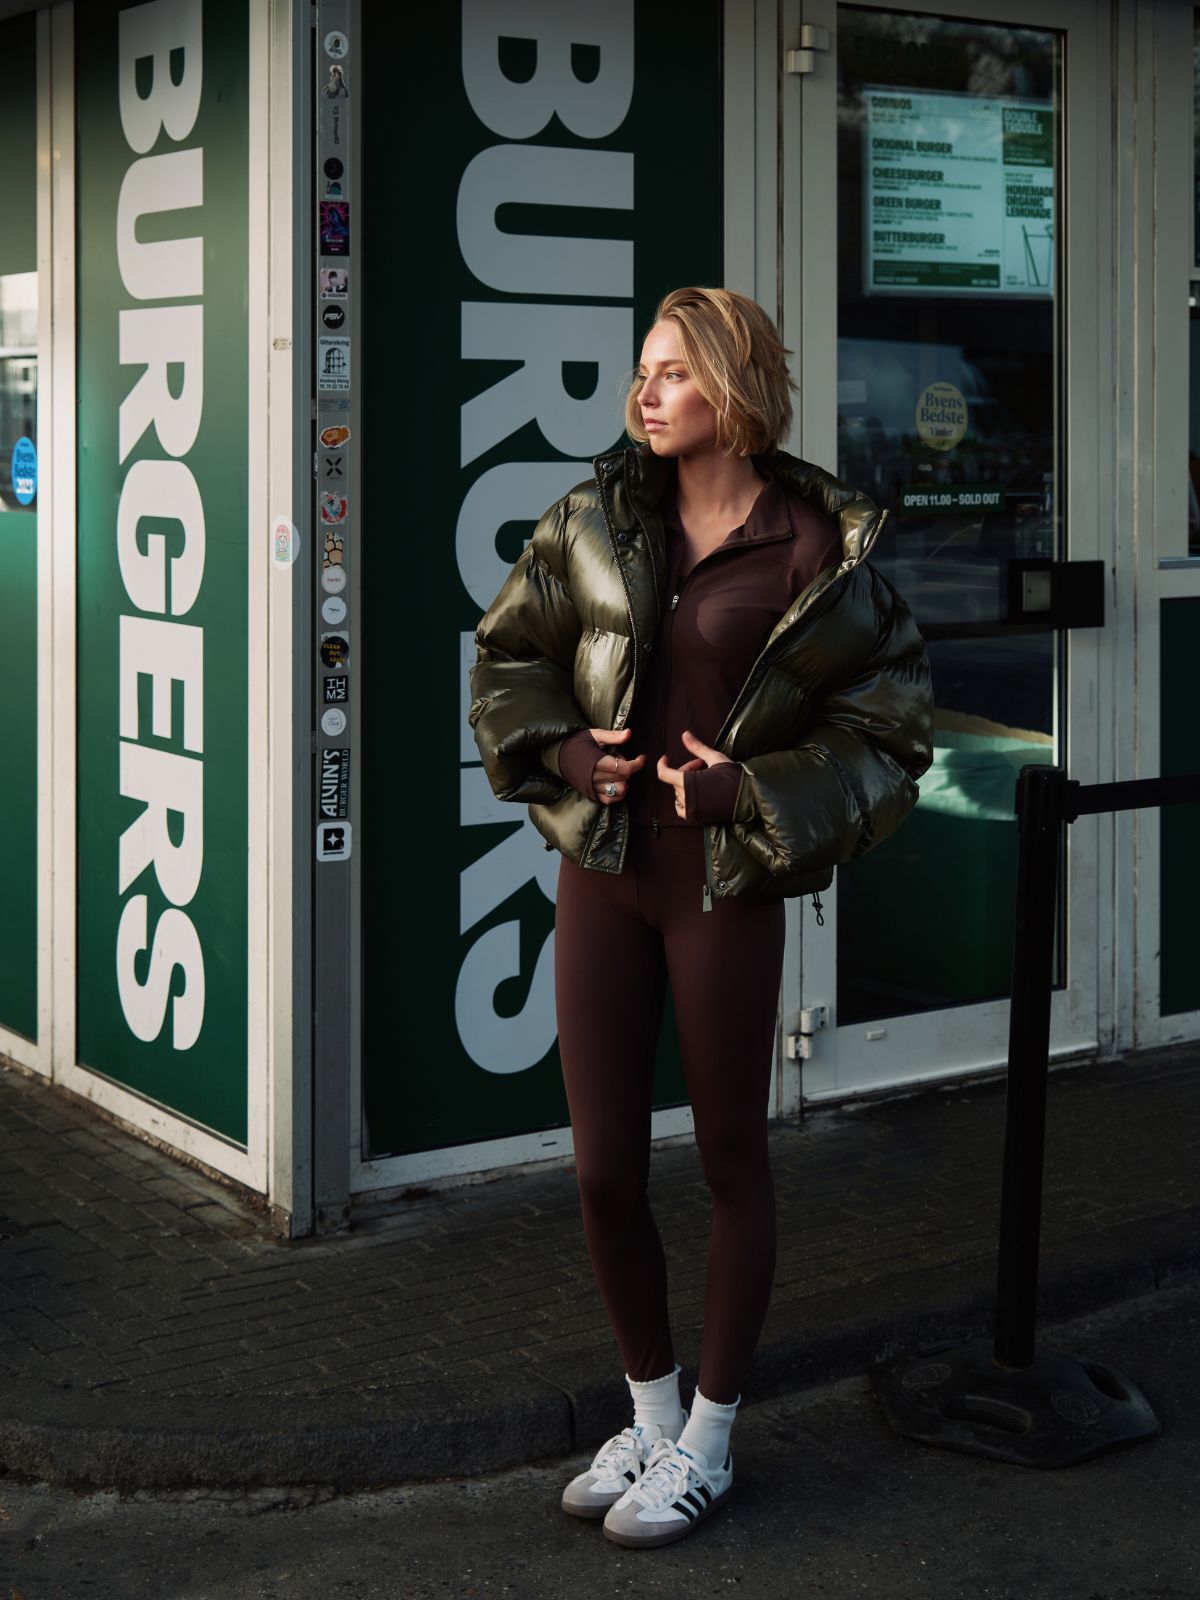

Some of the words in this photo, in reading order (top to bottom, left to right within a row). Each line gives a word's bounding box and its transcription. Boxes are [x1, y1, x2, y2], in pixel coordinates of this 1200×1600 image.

[1004, 110, 1038, 122] DOUBLE
[1004, 122, 1044, 135] TROUBLE
[872, 138, 914, 151] ORIGINAL
[916, 140, 954, 154] BURGER
[872, 167, 945, 182] CHEESEBURGER
[872, 196, 903, 209] GREEN
[904, 198, 942, 210] BURGER
[1006, 196, 1044, 208] ORGANIC
[1006, 207, 1052, 219] LEMONADE
[873, 230, 946, 245] BUTTERBURGER
[925, 392, 962, 410] Byens
[920, 407, 964, 424] Bedste
[904, 495, 928, 506] OPEN
[929, 494, 952, 506] 11.00
[958, 494, 981, 506] SOLD
[982, 492, 1000, 504] OUT
[117, 0, 205, 1050] BURGERS
[341, 749, 350, 781] WORLD
[321, 749, 340, 818] ALVIN'S
[339, 783, 348, 817] BURGER
